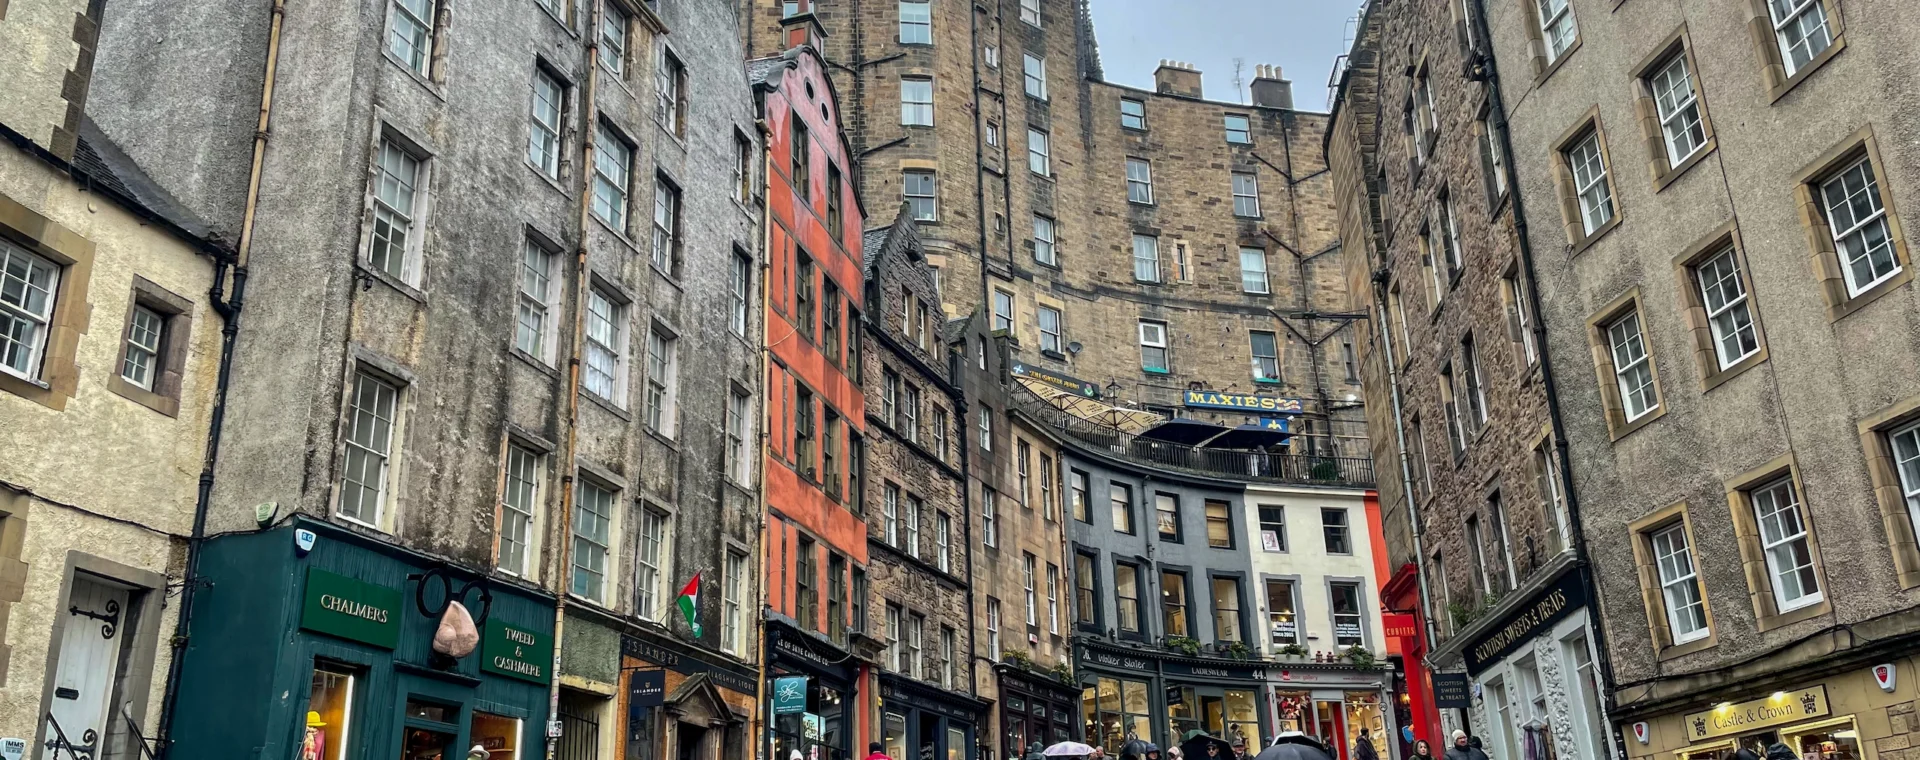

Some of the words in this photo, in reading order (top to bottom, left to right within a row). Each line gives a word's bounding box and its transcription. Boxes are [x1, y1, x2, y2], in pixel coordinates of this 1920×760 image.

[1188, 391, 1276, 409] MAXIES
[321, 594, 388, 623] CHALMERS
[1475, 631, 1506, 664] SCOTTISH
[1504, 613, 1531, 644] SWEETS
[1530, 608, 1539, 626] &
[1537, 588, 1566, 621] TREATS
[505, 627, 535, 646] TWEED
[515, 646, 522, 658] &
[1098, 653, 1120, 665] Walker
[1124, 657, 1146, 669] Slater
[494, 656, 541, 677] CASHMERE
[1191, 667, 1229, 677] LADIESWEAR
[738, 680, 755, 691] STORE
[1713, 711, 1743, 729] Castle
[1746, 708, 1756, 723] &
[1758, 704, 1793, 720] Crown
